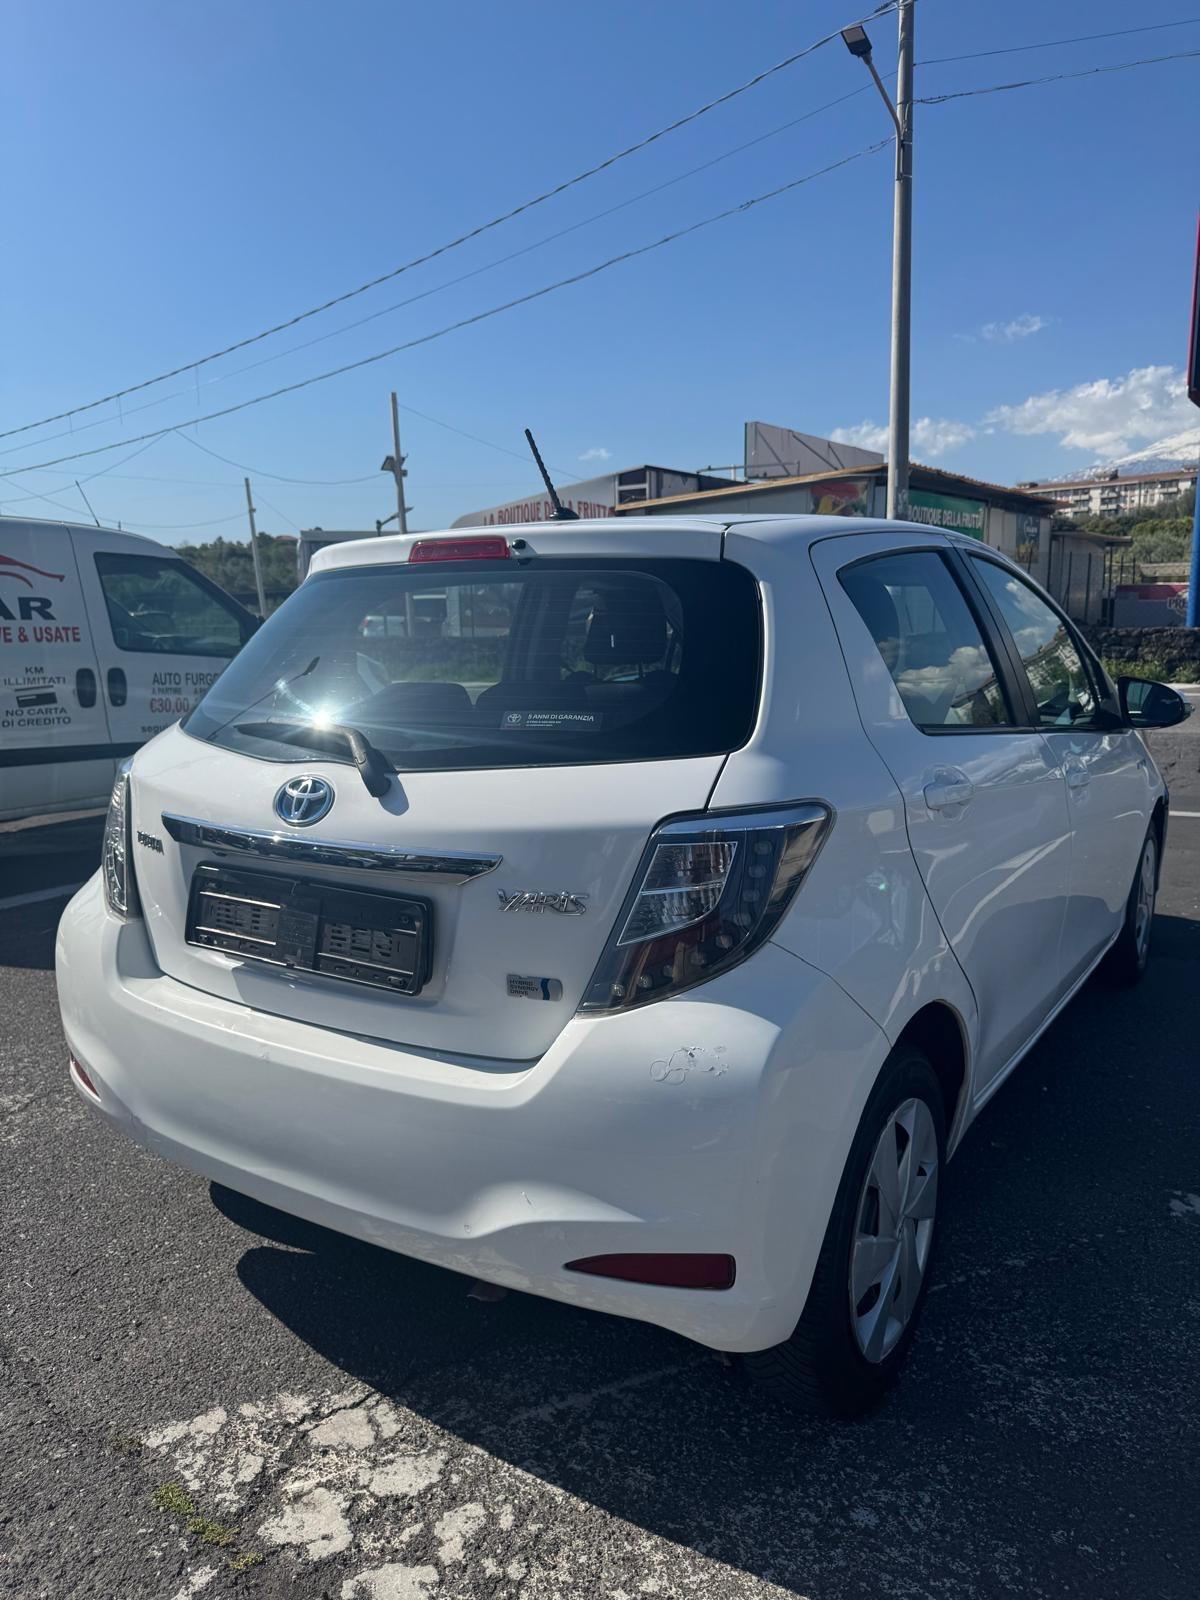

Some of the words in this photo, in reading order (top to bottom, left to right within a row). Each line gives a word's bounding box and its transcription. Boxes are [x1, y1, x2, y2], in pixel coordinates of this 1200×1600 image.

[497, 502, 542, 525] BOUTIQUE
[907, 505, 942, 526] BOUTIQUE
[942, 510, 962, 528] DELLA
[18, 626, 29, 643] &
[32, 626, 81, 643] USATE
[25, 666, 45, 674] KM
[4, 676, 67, 686] ILLIMITATI
[152, 671, 181, 686] AUTO
[5, 709, 24, 718] NO
[27, 706, 68, 716] CARTA
[558, 714, 594, 722] GARANZIA
[1, 719, 14, 729] DI
[17, 716, 72, 727] CREDITO
